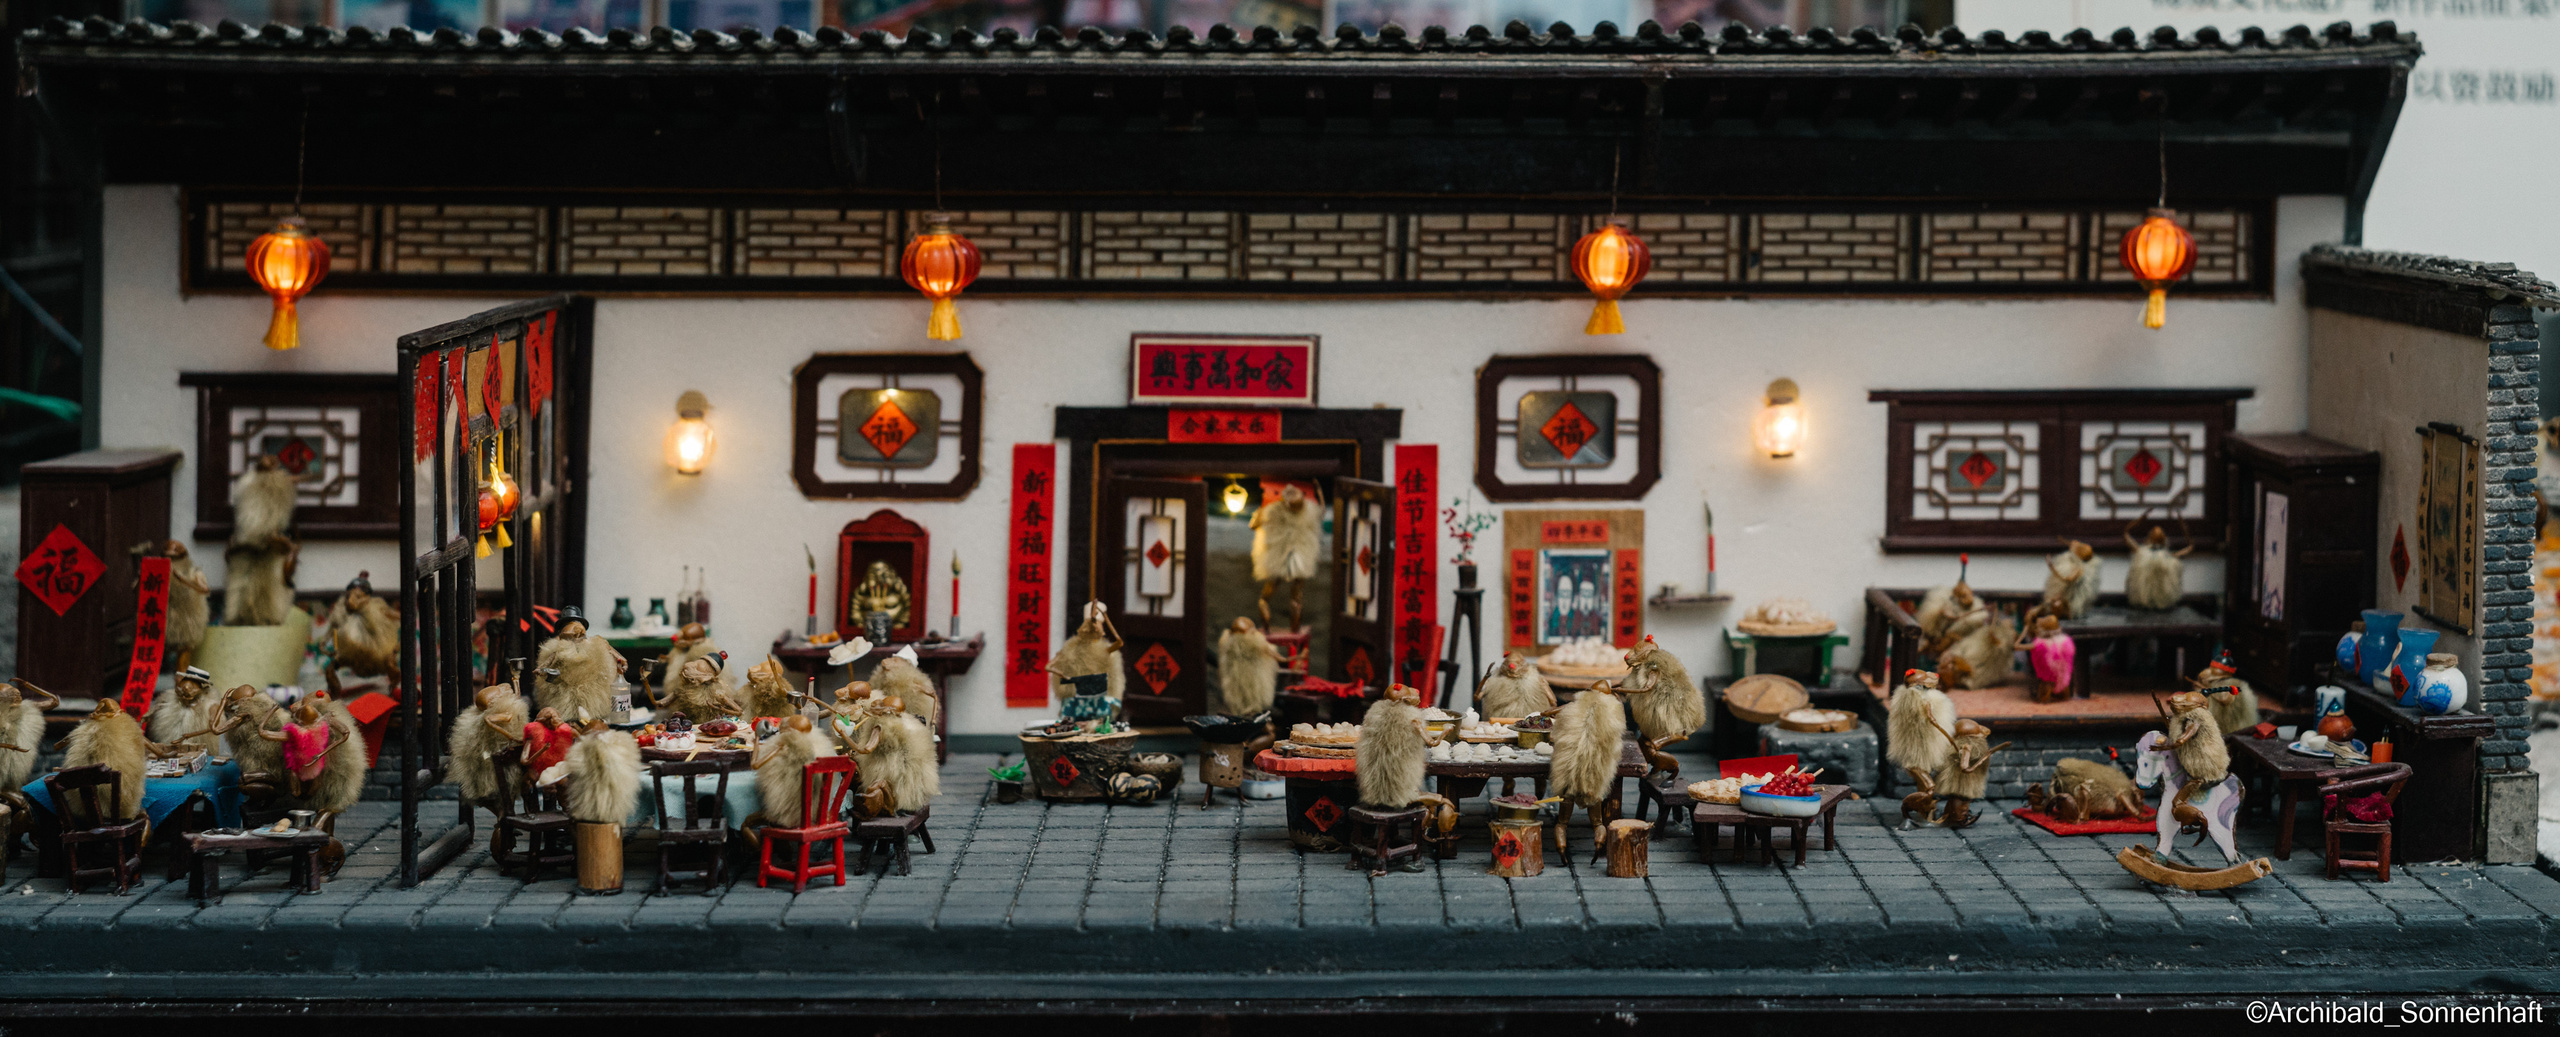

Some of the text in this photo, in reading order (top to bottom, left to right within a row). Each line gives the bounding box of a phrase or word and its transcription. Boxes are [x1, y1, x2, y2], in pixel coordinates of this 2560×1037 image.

[870, 416, 904, 446] 福
[1551, 417, 1586, 447] 福
[33, 546, 85, 597] 福
[1144, 654, 1172, 683] 福
[1315, 803, 1334, 821] 福
[1499, 839, 1519, 858] 福
